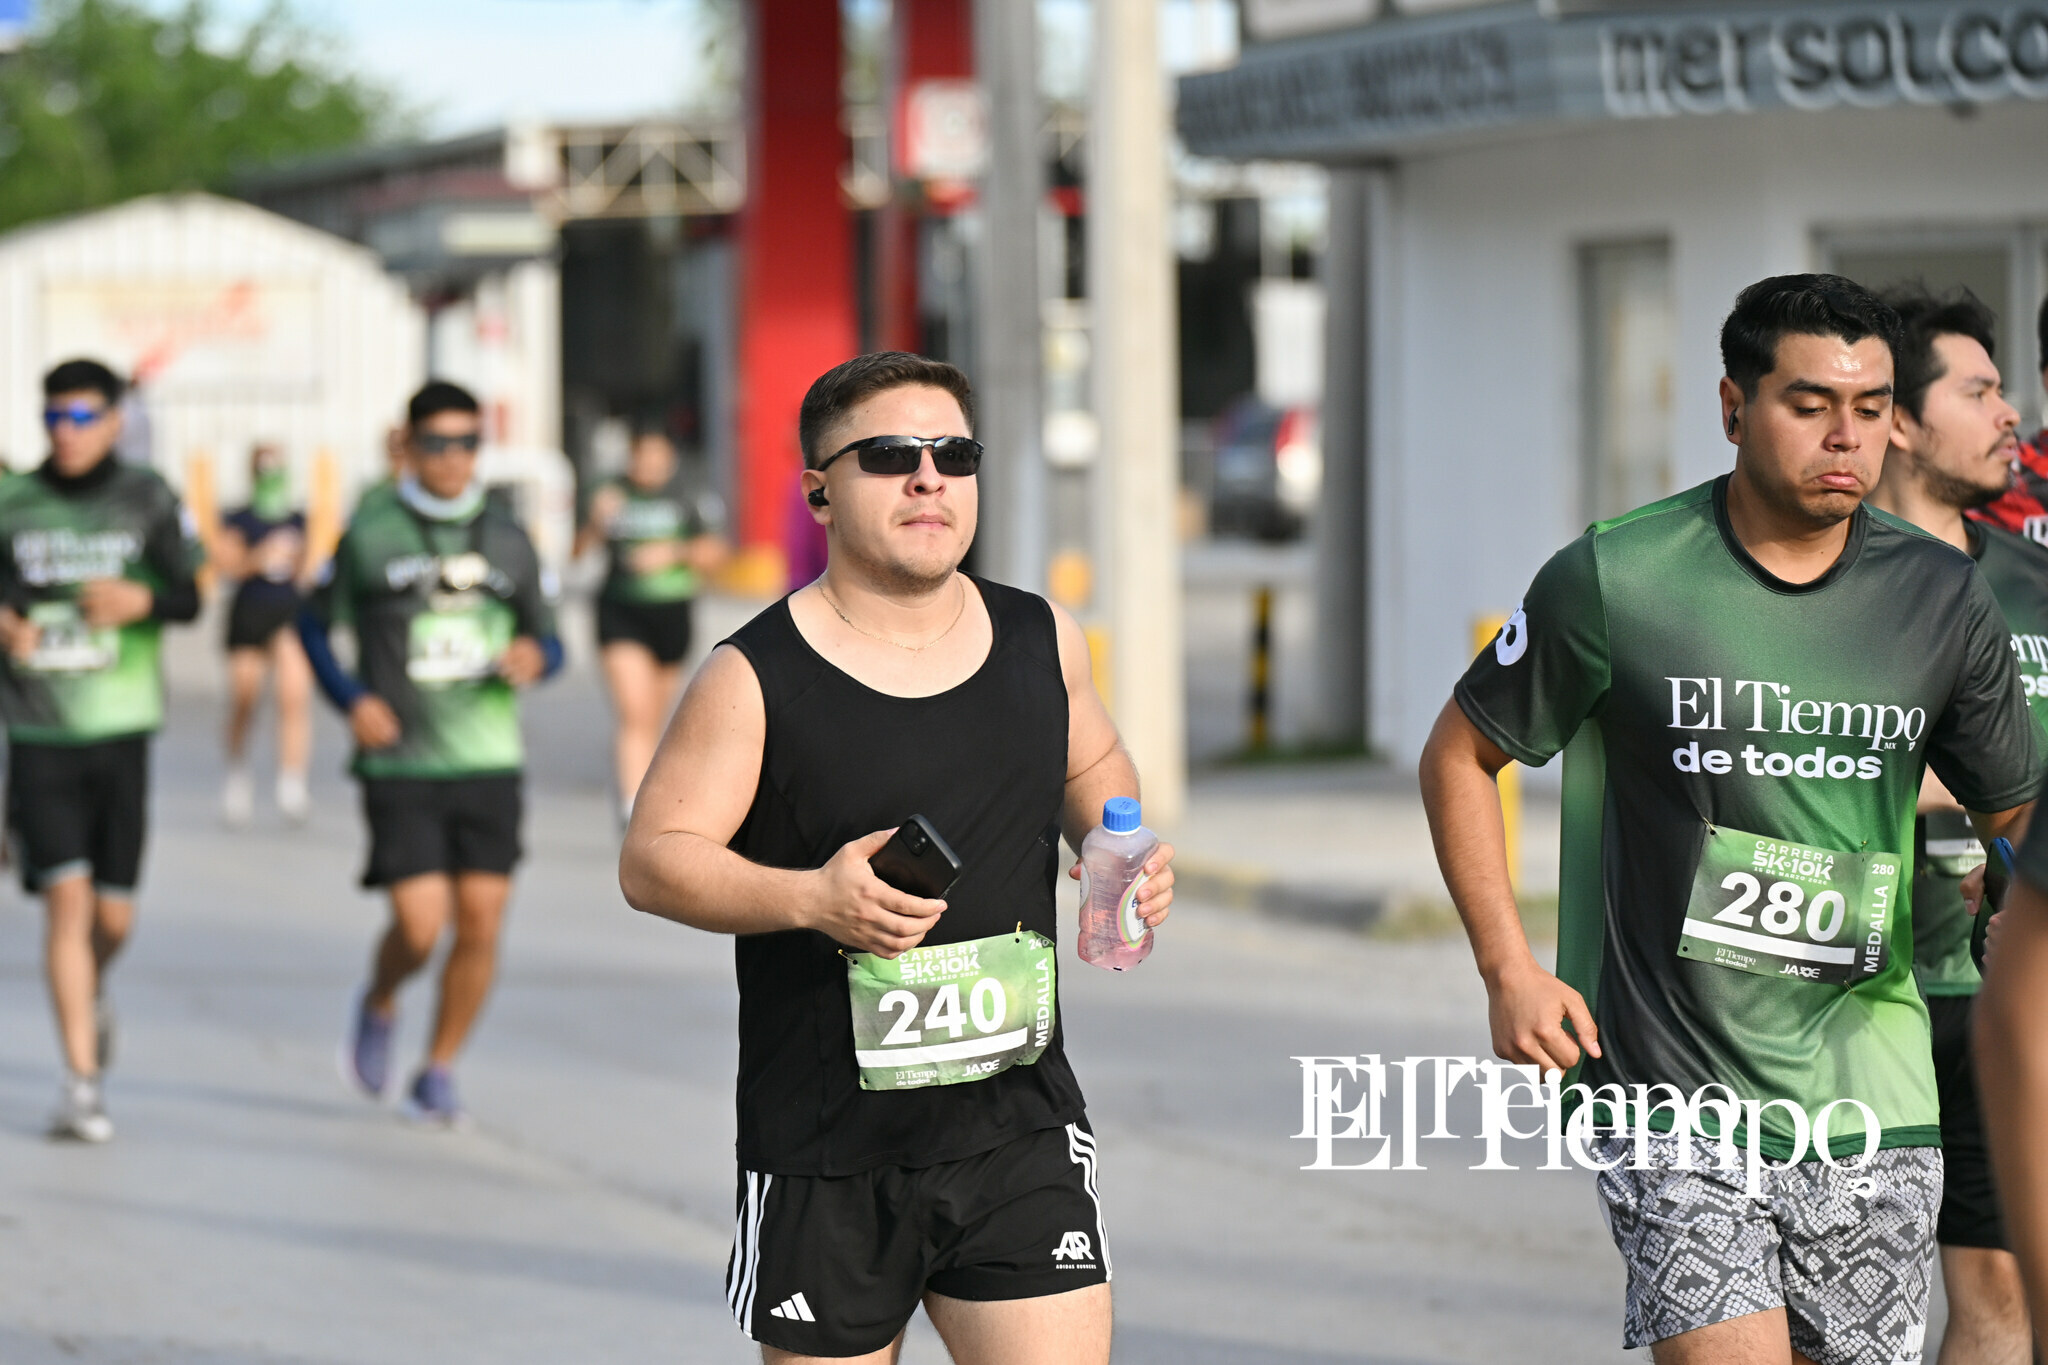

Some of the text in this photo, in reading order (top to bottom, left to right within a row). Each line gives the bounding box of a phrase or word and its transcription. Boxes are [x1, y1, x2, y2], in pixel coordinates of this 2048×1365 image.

[1664, 676, 1926, 751] El Tiempo
[1672, 741, 1883, 780] de todos
[1755, 840, 1834, 865] CARRERA
[1779, 871, 1806, 881] MARZO
[1872, 863, 1895, 876] 280
[1712, 871, 1846, 942] 280
[1863, 885, 1889, 973] MEDALLA
[899, 943, 978, 963] CARRERA
[1716, 947, 1757, 966] El Tiempo
[1726, 958, 1748, 969] todos
[878, 977, 1007, 1046] 240
[1035, 957, 1050, 1047] MEDALLA
[896, 1070, 938, 1080] El Tiempo
